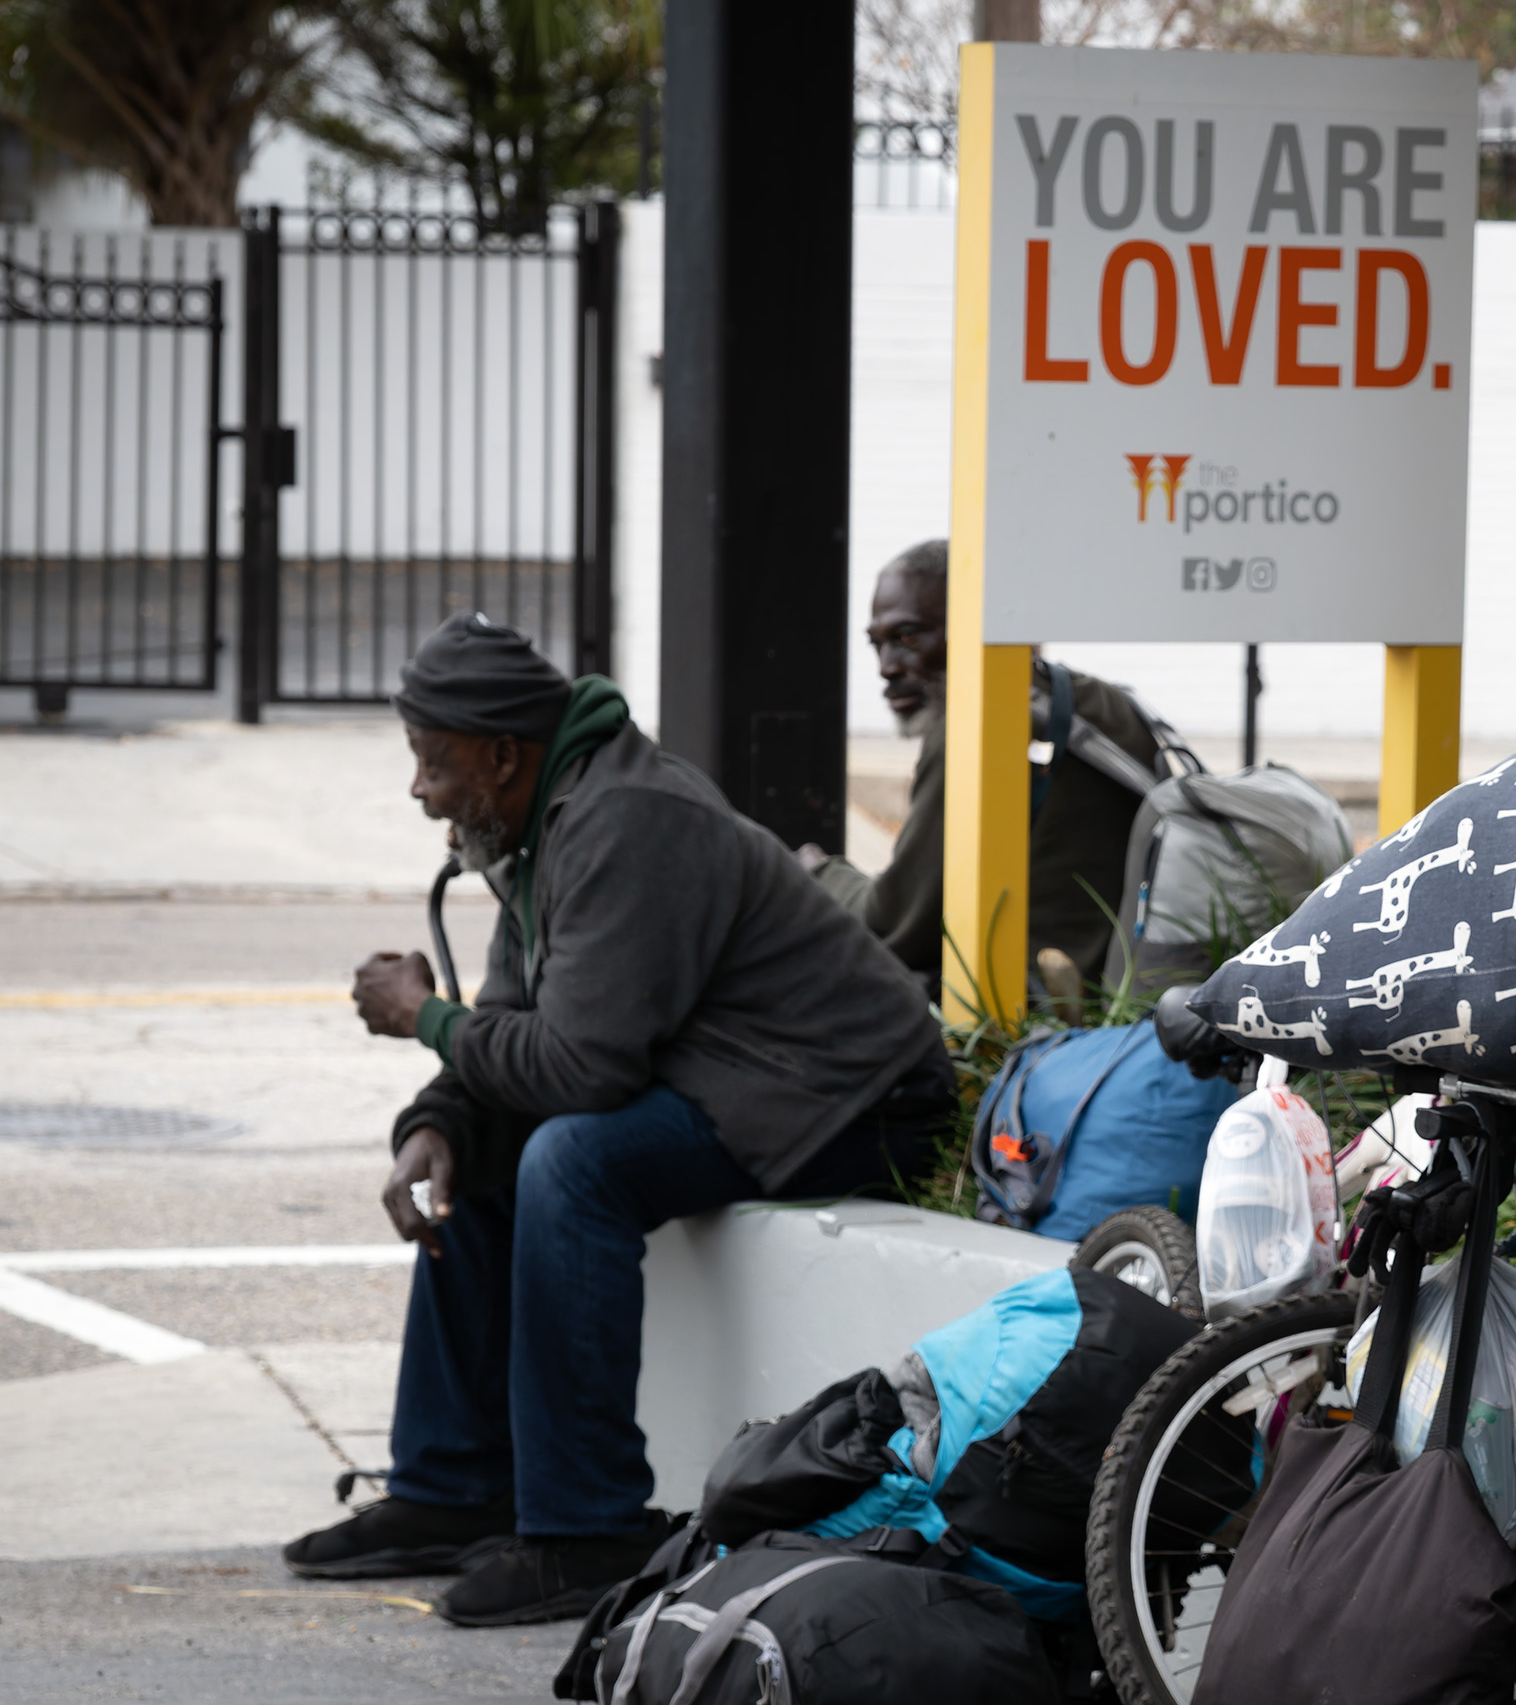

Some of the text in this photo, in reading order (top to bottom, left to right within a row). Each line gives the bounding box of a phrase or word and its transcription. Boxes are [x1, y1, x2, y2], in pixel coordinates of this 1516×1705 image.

[1015, 114, 1447, 238] YOU ARE
[1022, 239, 1452, 389] LOVED.
[1183, 478, 1340, 534] portico
[1199, 460, 1238, 487] the
